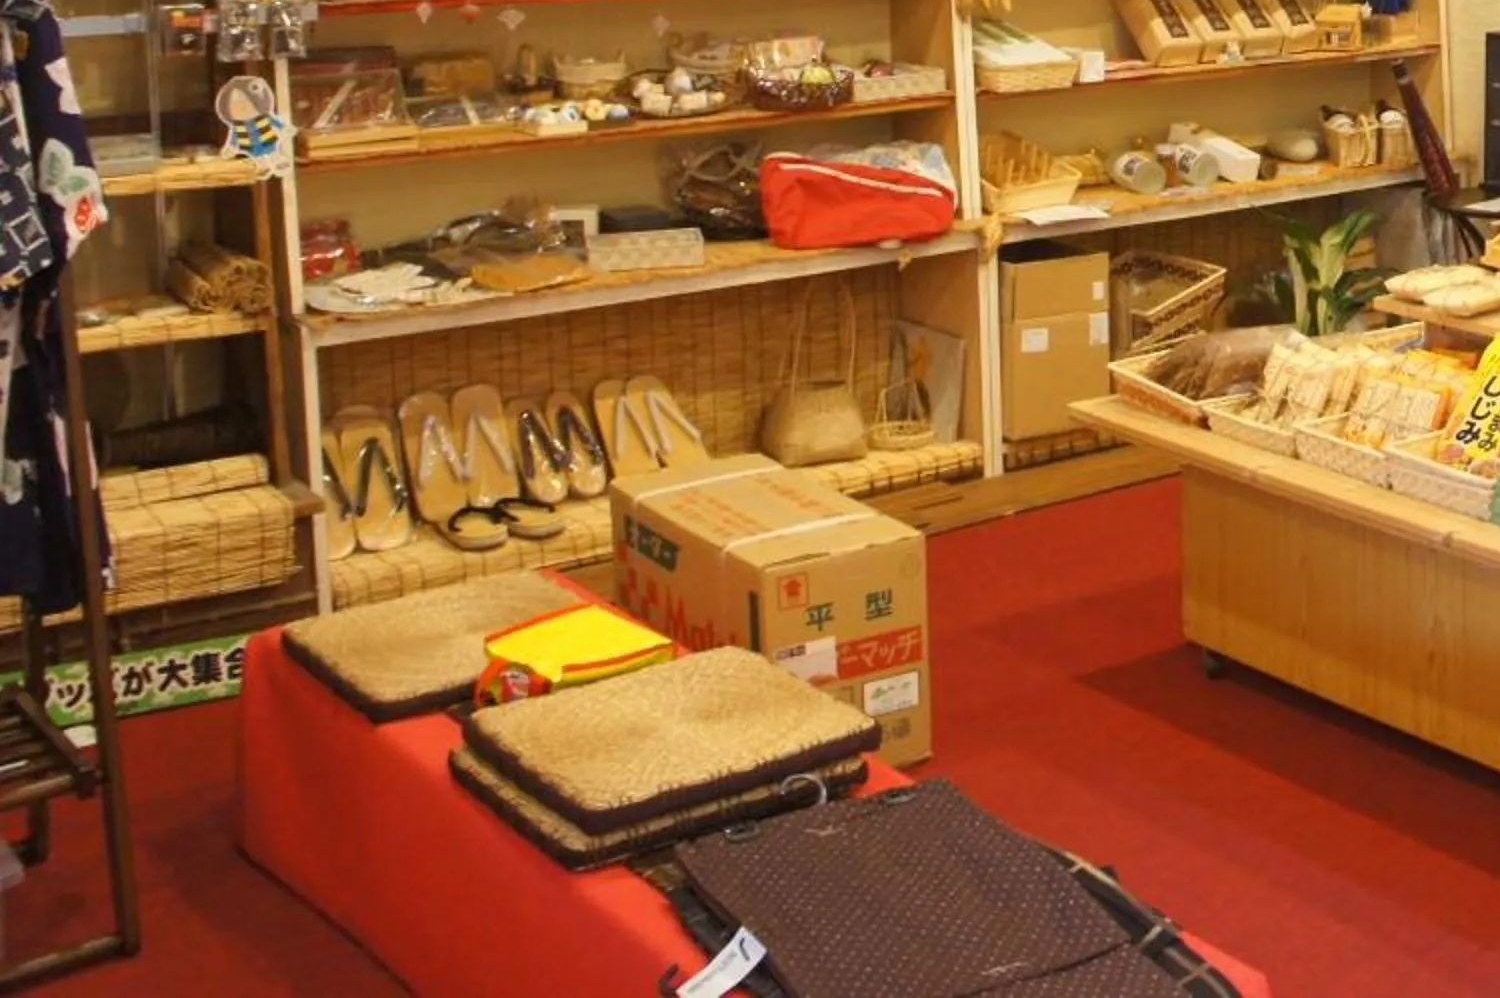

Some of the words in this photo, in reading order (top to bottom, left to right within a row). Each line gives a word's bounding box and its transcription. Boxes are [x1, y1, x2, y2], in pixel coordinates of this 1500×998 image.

[57, 647, 243, 708] ッが大集合
